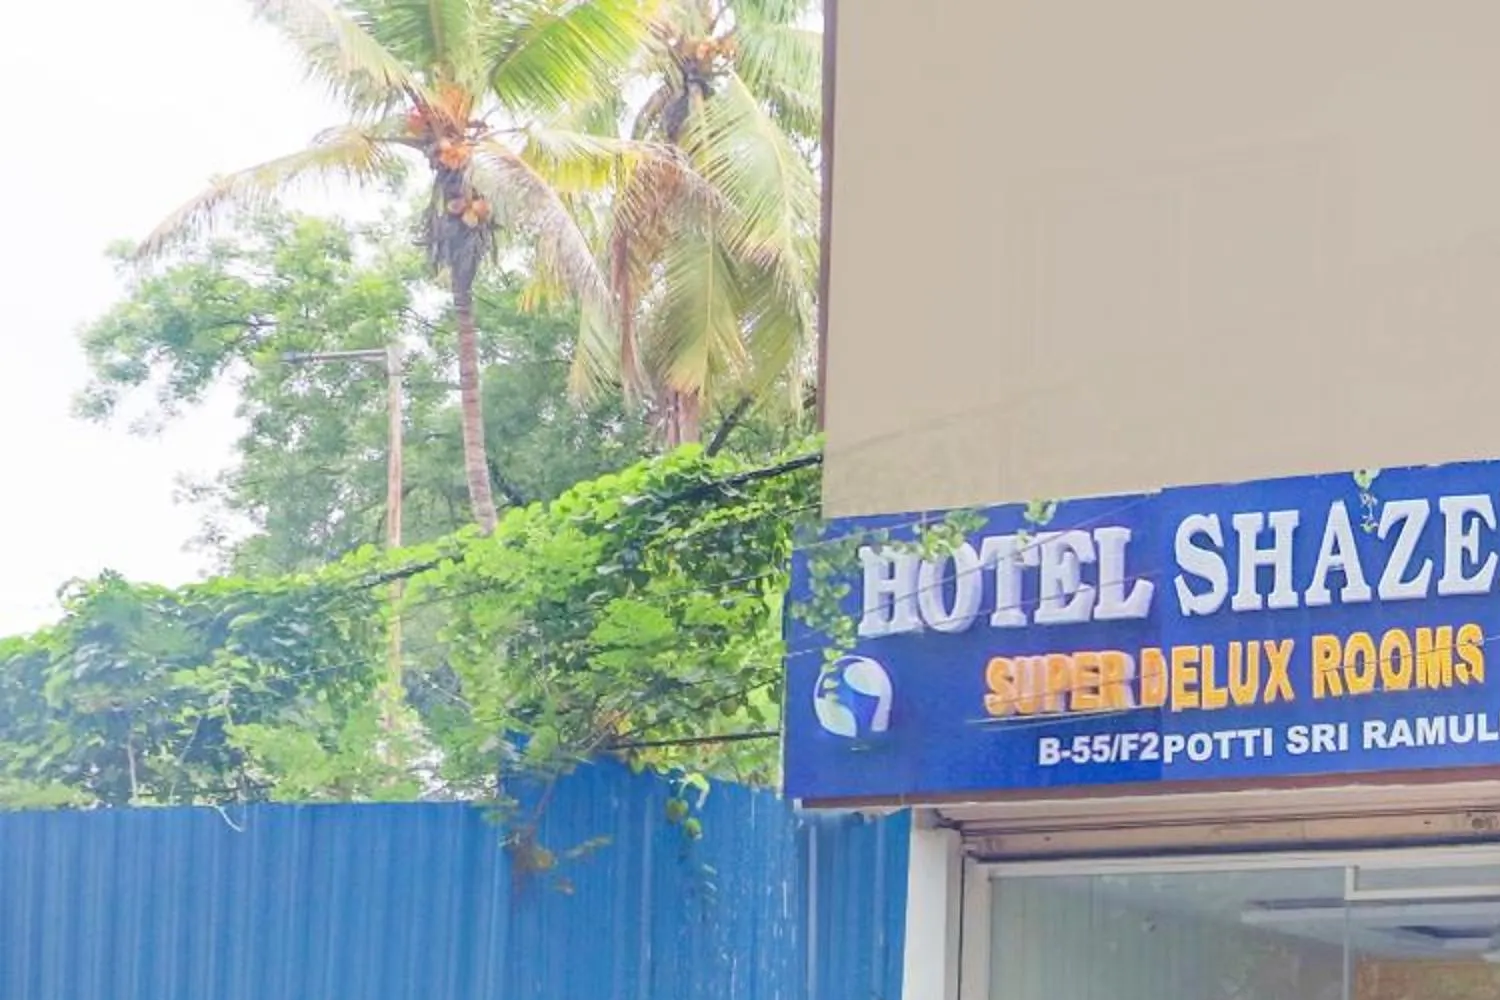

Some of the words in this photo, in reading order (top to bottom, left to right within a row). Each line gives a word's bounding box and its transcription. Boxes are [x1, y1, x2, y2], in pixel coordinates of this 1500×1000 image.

[858, 526, 1155, 637] HOTEL
[984, 650, 1135, 716] SUPER
[1140, 639, 1294, 712] DELUX
[1311, 622, 1485, 698] ROOMS
[1286, 722, 1348, 756] SRI
